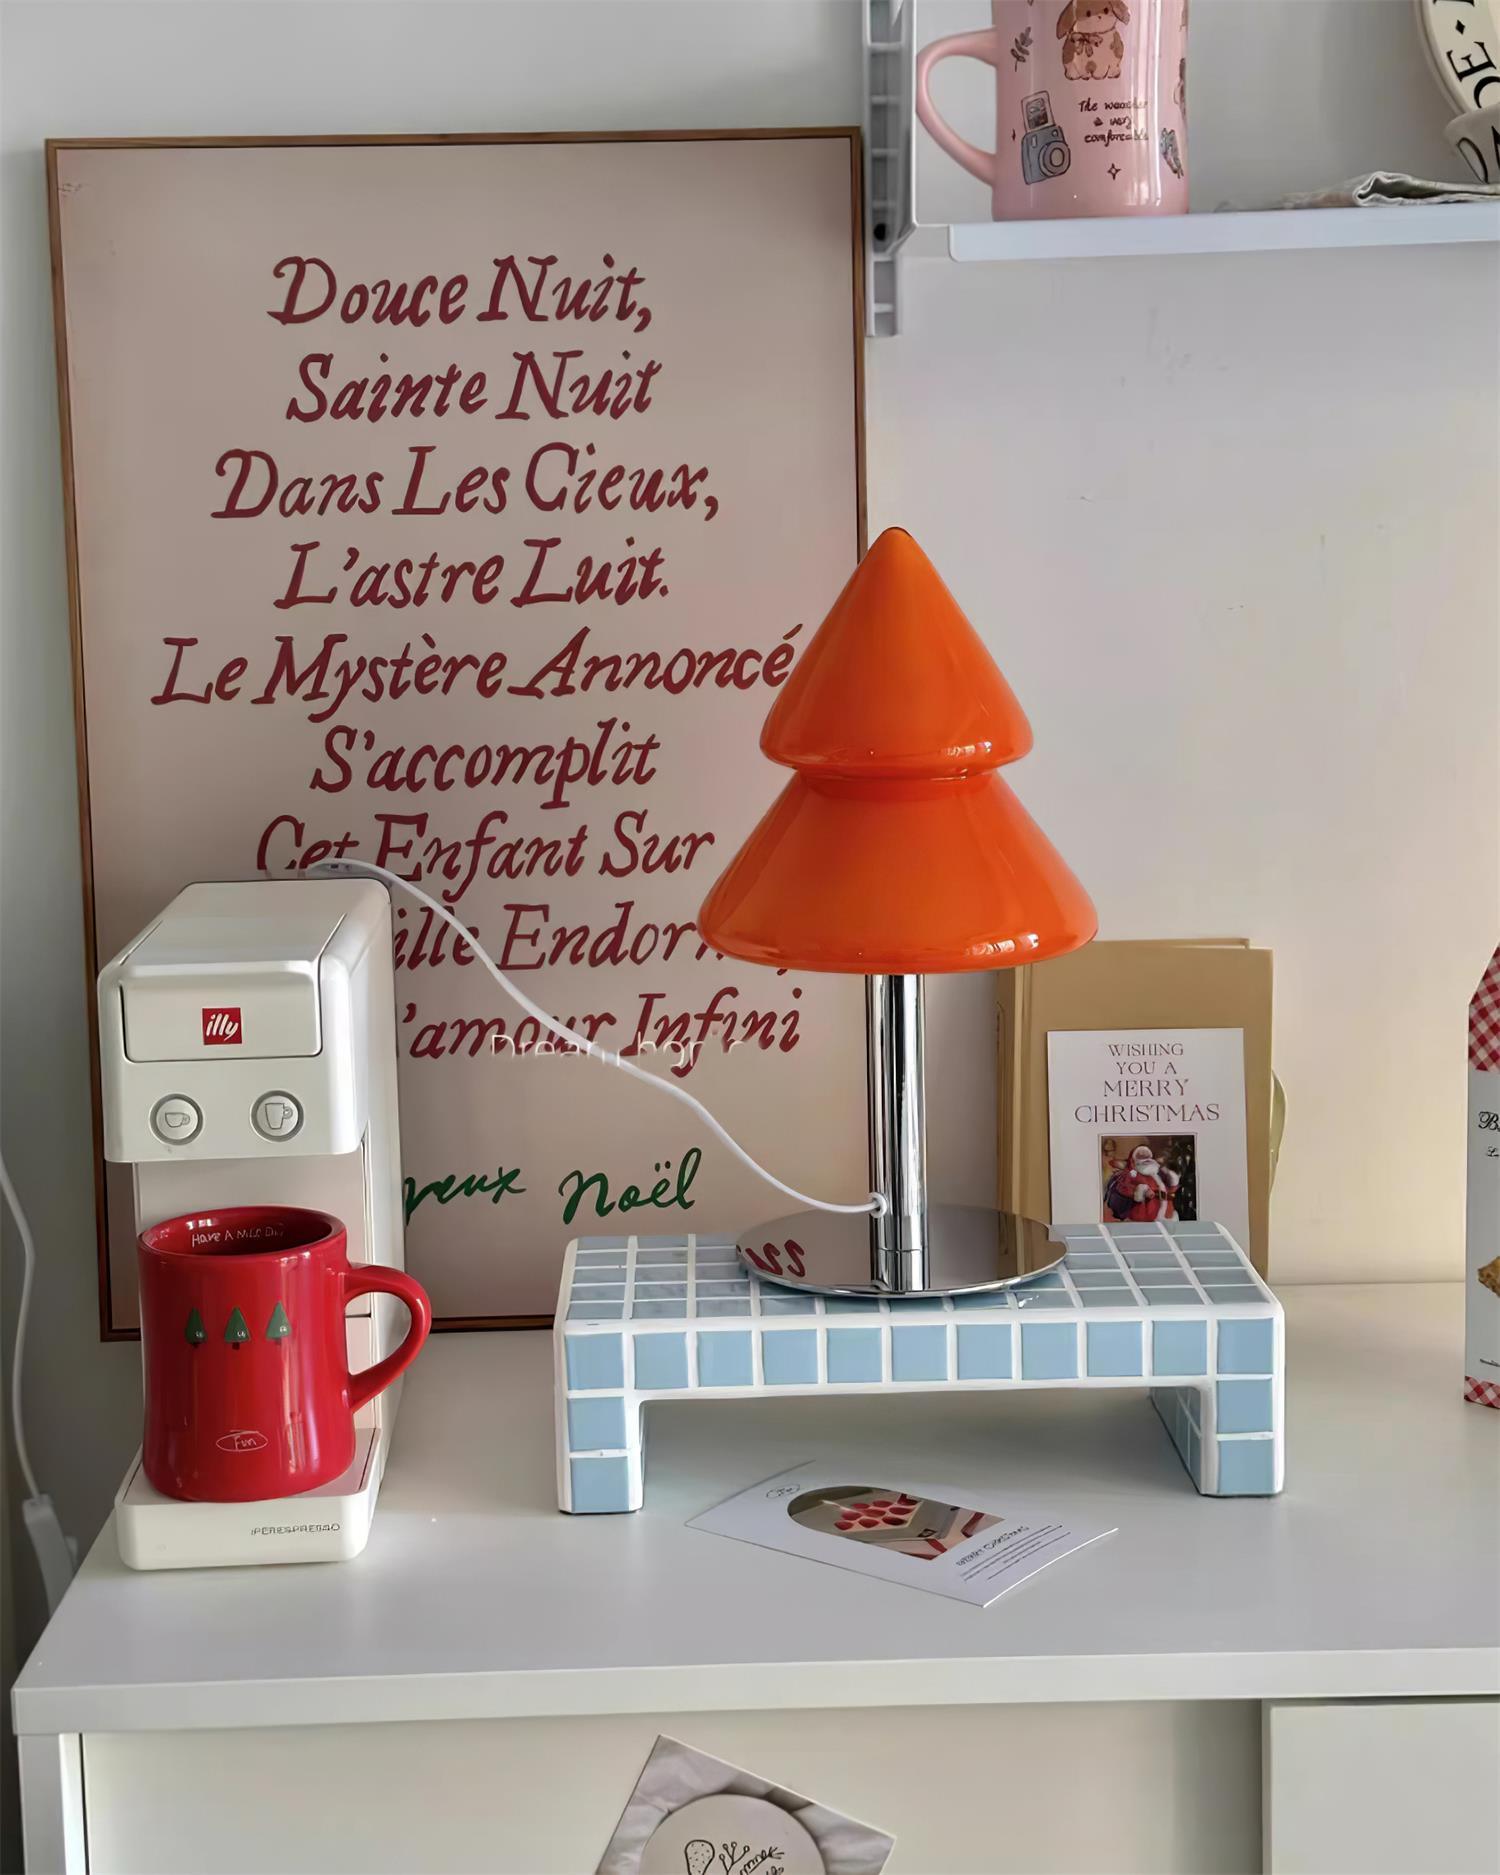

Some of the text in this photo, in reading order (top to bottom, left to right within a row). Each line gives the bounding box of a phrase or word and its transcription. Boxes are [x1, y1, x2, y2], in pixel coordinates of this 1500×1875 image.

[267, 254, 652, 333] Douce Nuit,
[286, 350, 662, 423] Sainte Nuit
[211, 441, 719, 521] Dans Les Cieux,
[273, 537, 669, 609] L'astre Luit.
[151, 624, 803, 722] Le Mystère Annoncé
[309, 716, 661, 810] S'accomplit
[374, 810, 588, 903] Enfant
[600, 809, 715, 878] Sur
[395, 900, 725, 971] ille Endor
[206, 1013, 239, 1041] illy
[402, 1002, 618, 1059] 'amour
[620, 986, 802, 1077] Infini
[1108, 1043, 1184, 1057] WISHING
[1103, 1079, 1189, 1097] MERRY
[1116, 1061, 1177, 1075] YOU A
[1074, 1104, 1220, 1123] CHRISTMAS
